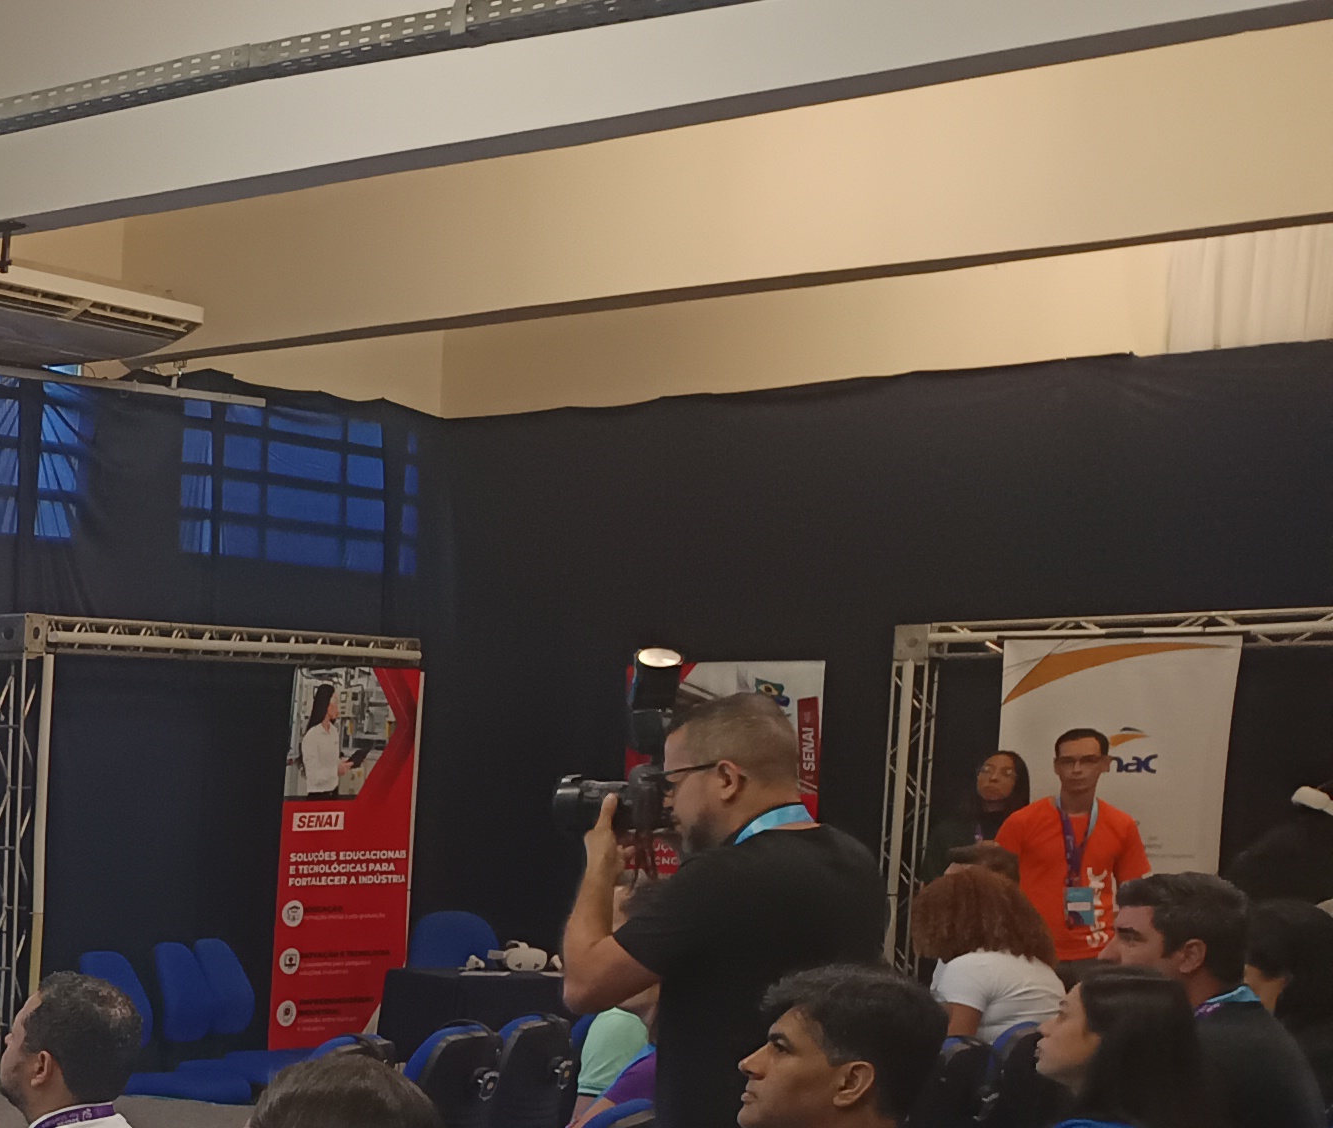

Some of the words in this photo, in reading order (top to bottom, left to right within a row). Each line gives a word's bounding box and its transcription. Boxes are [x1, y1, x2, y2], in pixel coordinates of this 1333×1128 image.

[802, 727, 815, 771] SENAI
[1109, 754, 1159, 774] nac
[297, 814, 340, 829] SENAI
[290, 850, 337, 863] SOLUÇÕES
[339, 850, 407, 860] EDUCACIONAIS
[289, 865, 296, 874] E
[298, 862, 367, 874] TECNOLÓGICAS
[369, 863, 395, 872] PARA
[288, 876, 347, 887] FORTALECER
[349, 876, 357, 885] A
[359, 873, 406, 885] INDÚSTRIA
